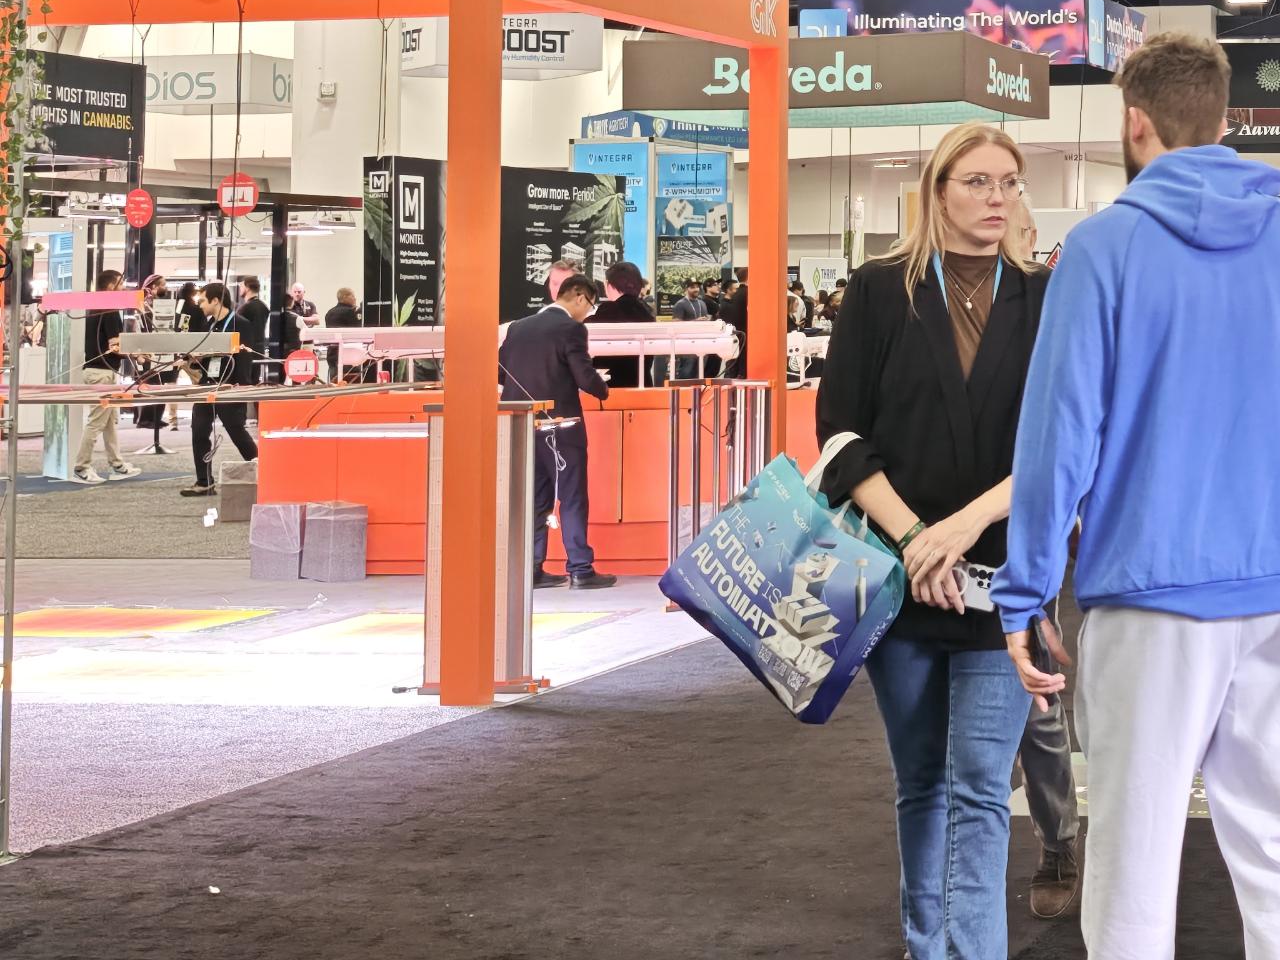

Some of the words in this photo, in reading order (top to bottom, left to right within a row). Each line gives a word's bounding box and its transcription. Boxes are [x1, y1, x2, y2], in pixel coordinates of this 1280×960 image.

[502, 17, 538, 28] TEGRA
[854, 12, 966, 31] Illuminating
[969, 12, 1004, 27] The
[1106, 13, 1123, 36] Dutch
[502, 29, 571, 53] OOST
[702, 50, 873, 96] Beda
[987, 57, 1031, 103] Boveda
[56, 85, 83, 104] MOST
[84, 89, 127, 109] TRUSTED
[70, 108, 81, 125] IN
[83, 111, 134, 131] CANNABIS.
[527, 183, 549, 199] Grow
[549, 187, 571, 200] more.
[399, 233, 425, 246] MONTEL
[728, 504, 751, 534] THE
[709, 519, 767, 592] FUTURE
[760, 576, 783, 605] IS
